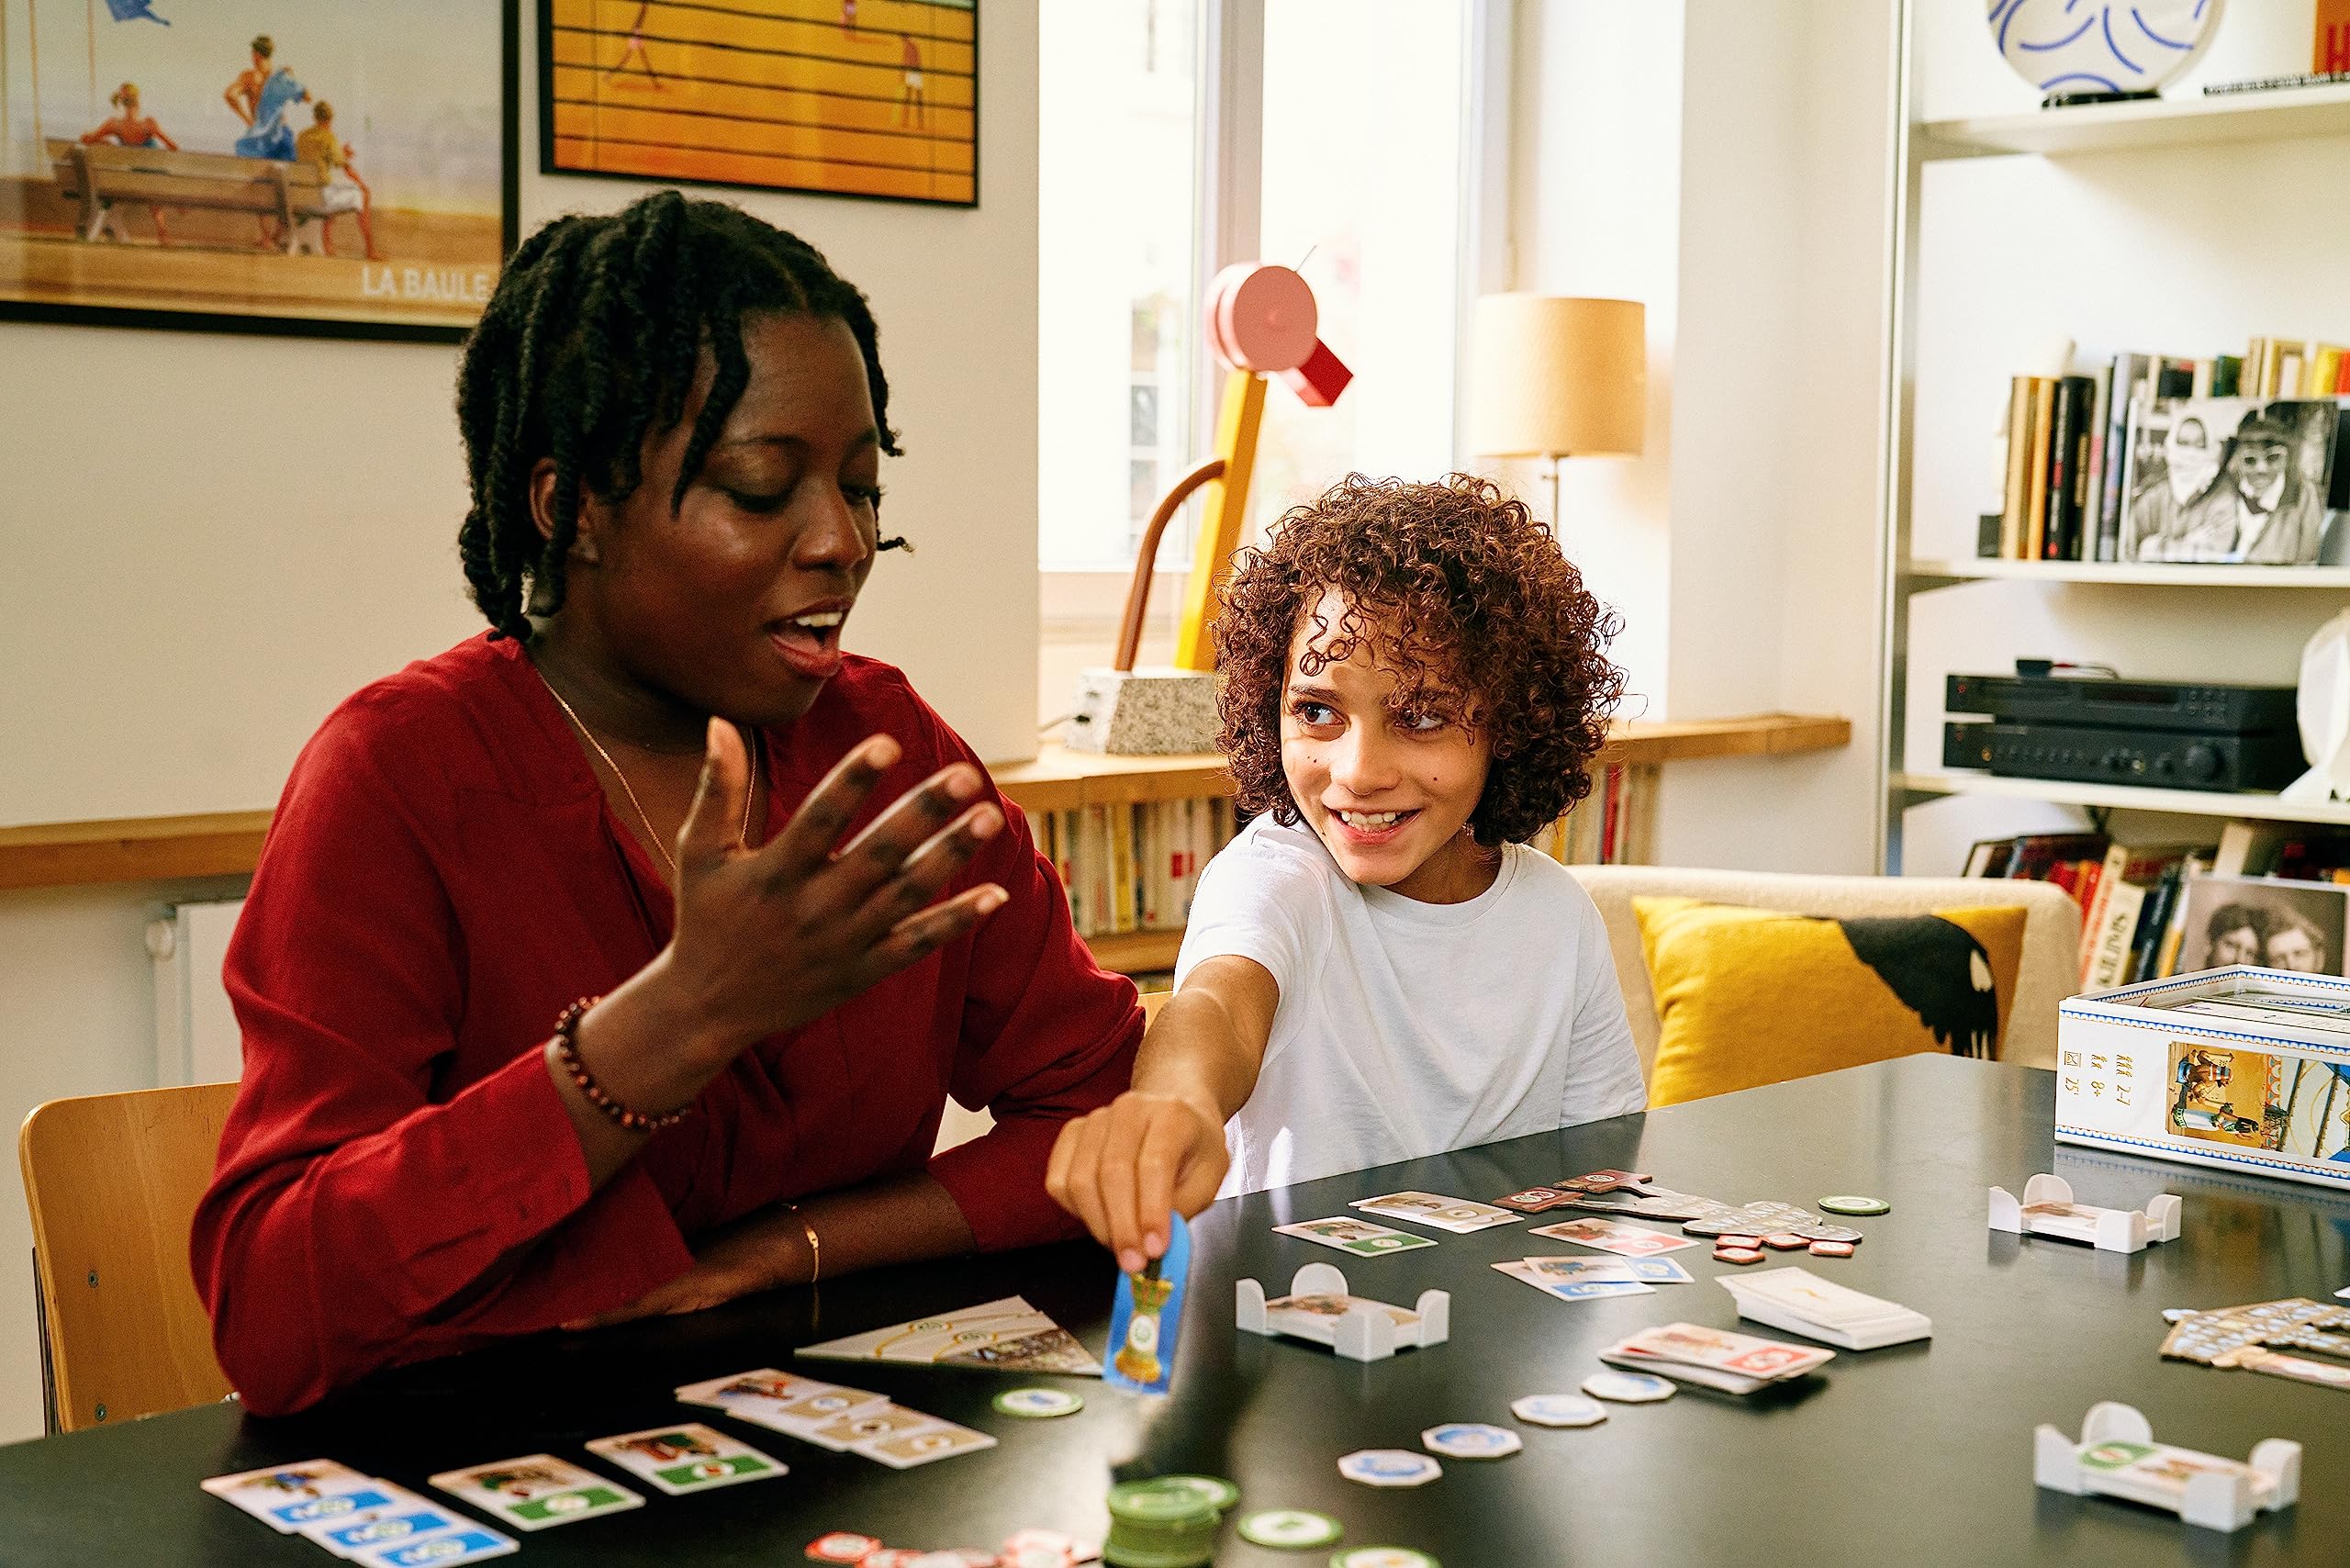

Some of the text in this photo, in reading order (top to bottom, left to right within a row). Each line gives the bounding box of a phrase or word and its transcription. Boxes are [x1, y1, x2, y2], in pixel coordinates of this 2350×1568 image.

[362, 265, 491, 301] LA BAULE
[2090, 1081, 2106, 1097] 8+
[2116, 1084, 2131, 1106] 2-7
